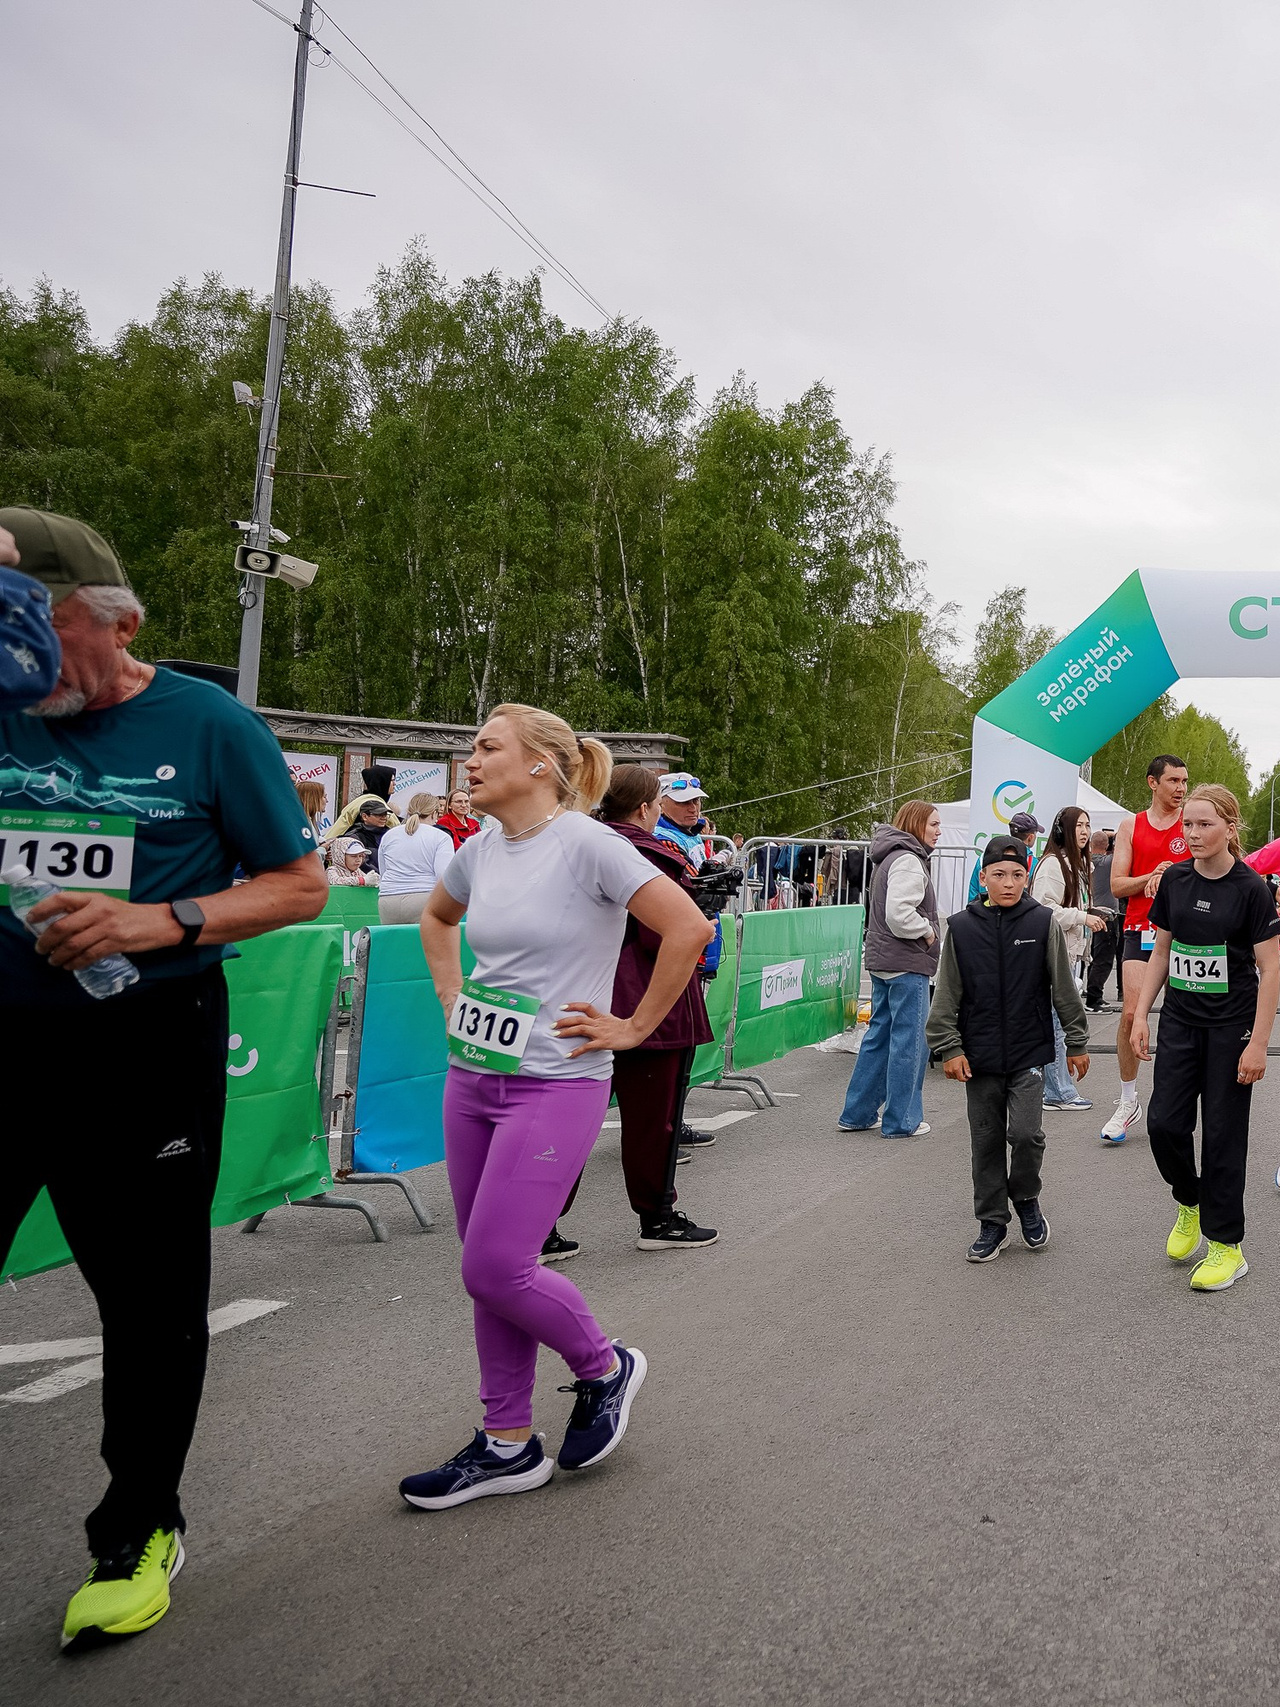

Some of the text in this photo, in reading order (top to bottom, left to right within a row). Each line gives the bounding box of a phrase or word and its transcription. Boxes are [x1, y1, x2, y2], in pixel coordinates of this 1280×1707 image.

[1036, 626, 1120, 707] зелёный
[1049, 645, 1134, 723] марафон
[297, 762, 331, 782] СИЕЙ
[394, 767, 442, 793] ВИЖЕНИИ
[1174, 956, 1221, 978] 1134
[775, 971, 798, 994] Прайм
[458, 1002, 520, 1047] 1310
[462, 1044, 487, 1062] 4,2км
